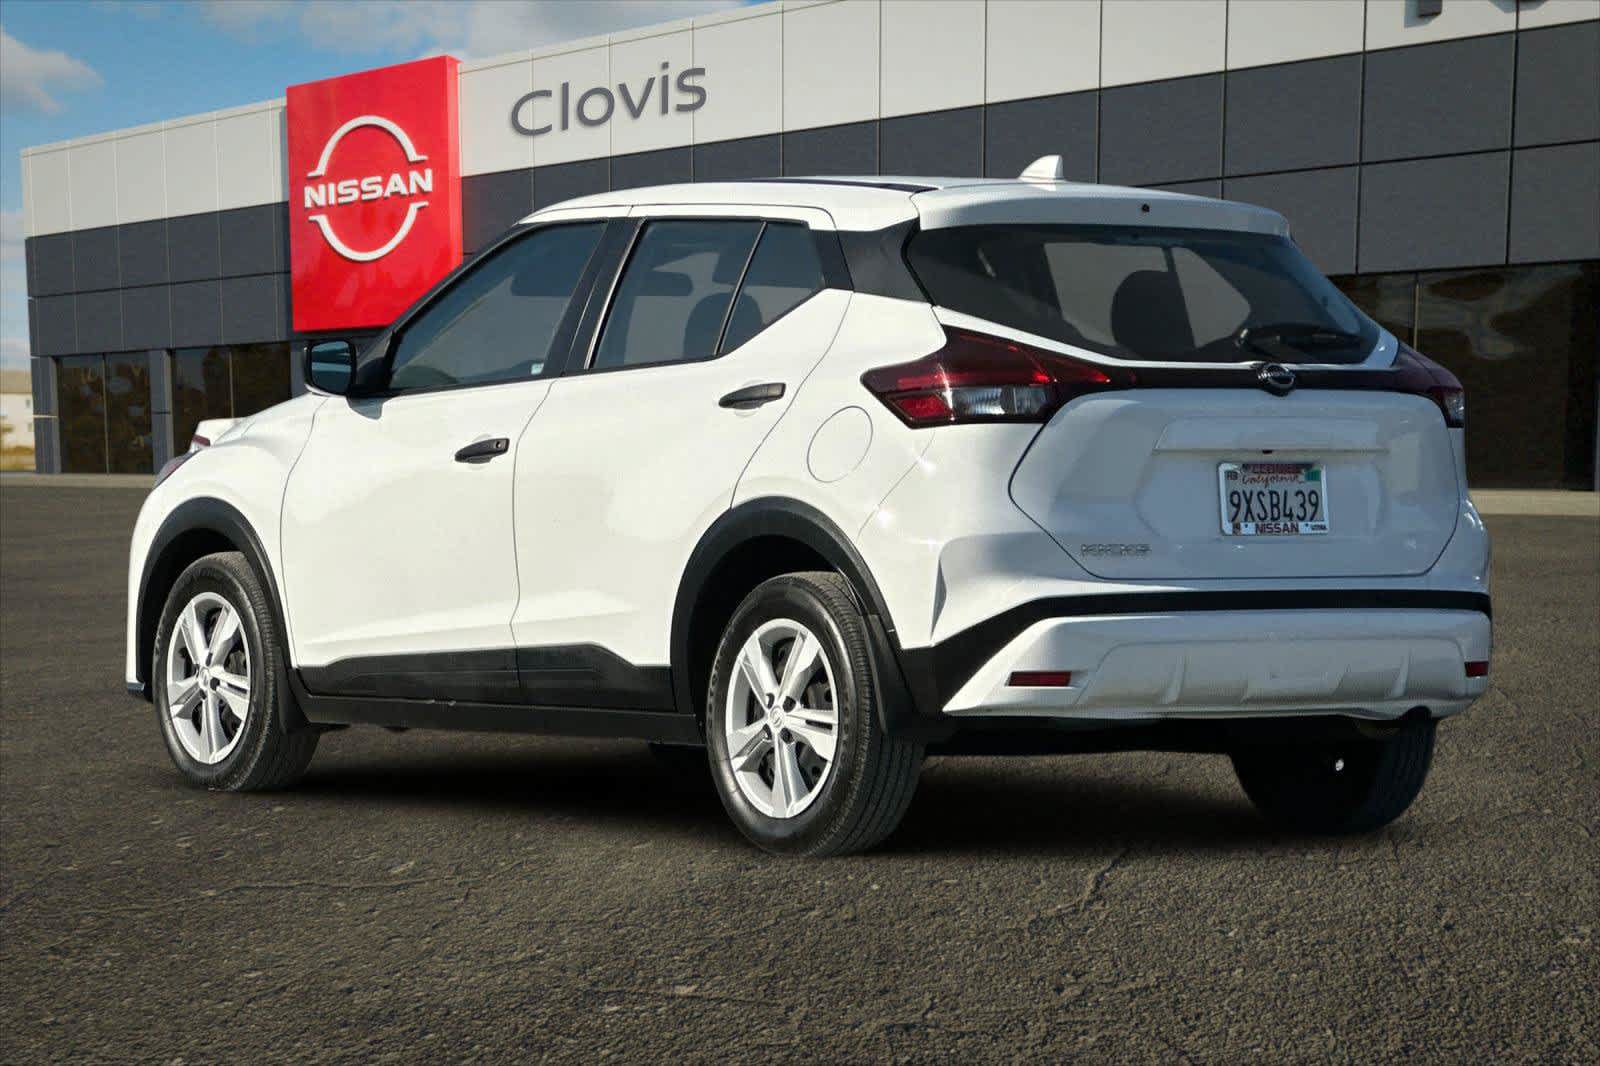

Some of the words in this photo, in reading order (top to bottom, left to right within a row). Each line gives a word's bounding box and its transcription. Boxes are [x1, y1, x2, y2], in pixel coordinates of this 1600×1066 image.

[511, 61, 707, 136] Clovis
[304, 168, 433, 209] NISSAN
[1229, 489, 1320, 522] 9XSB439
[1255, 521, 1299, 534] NISSAN
